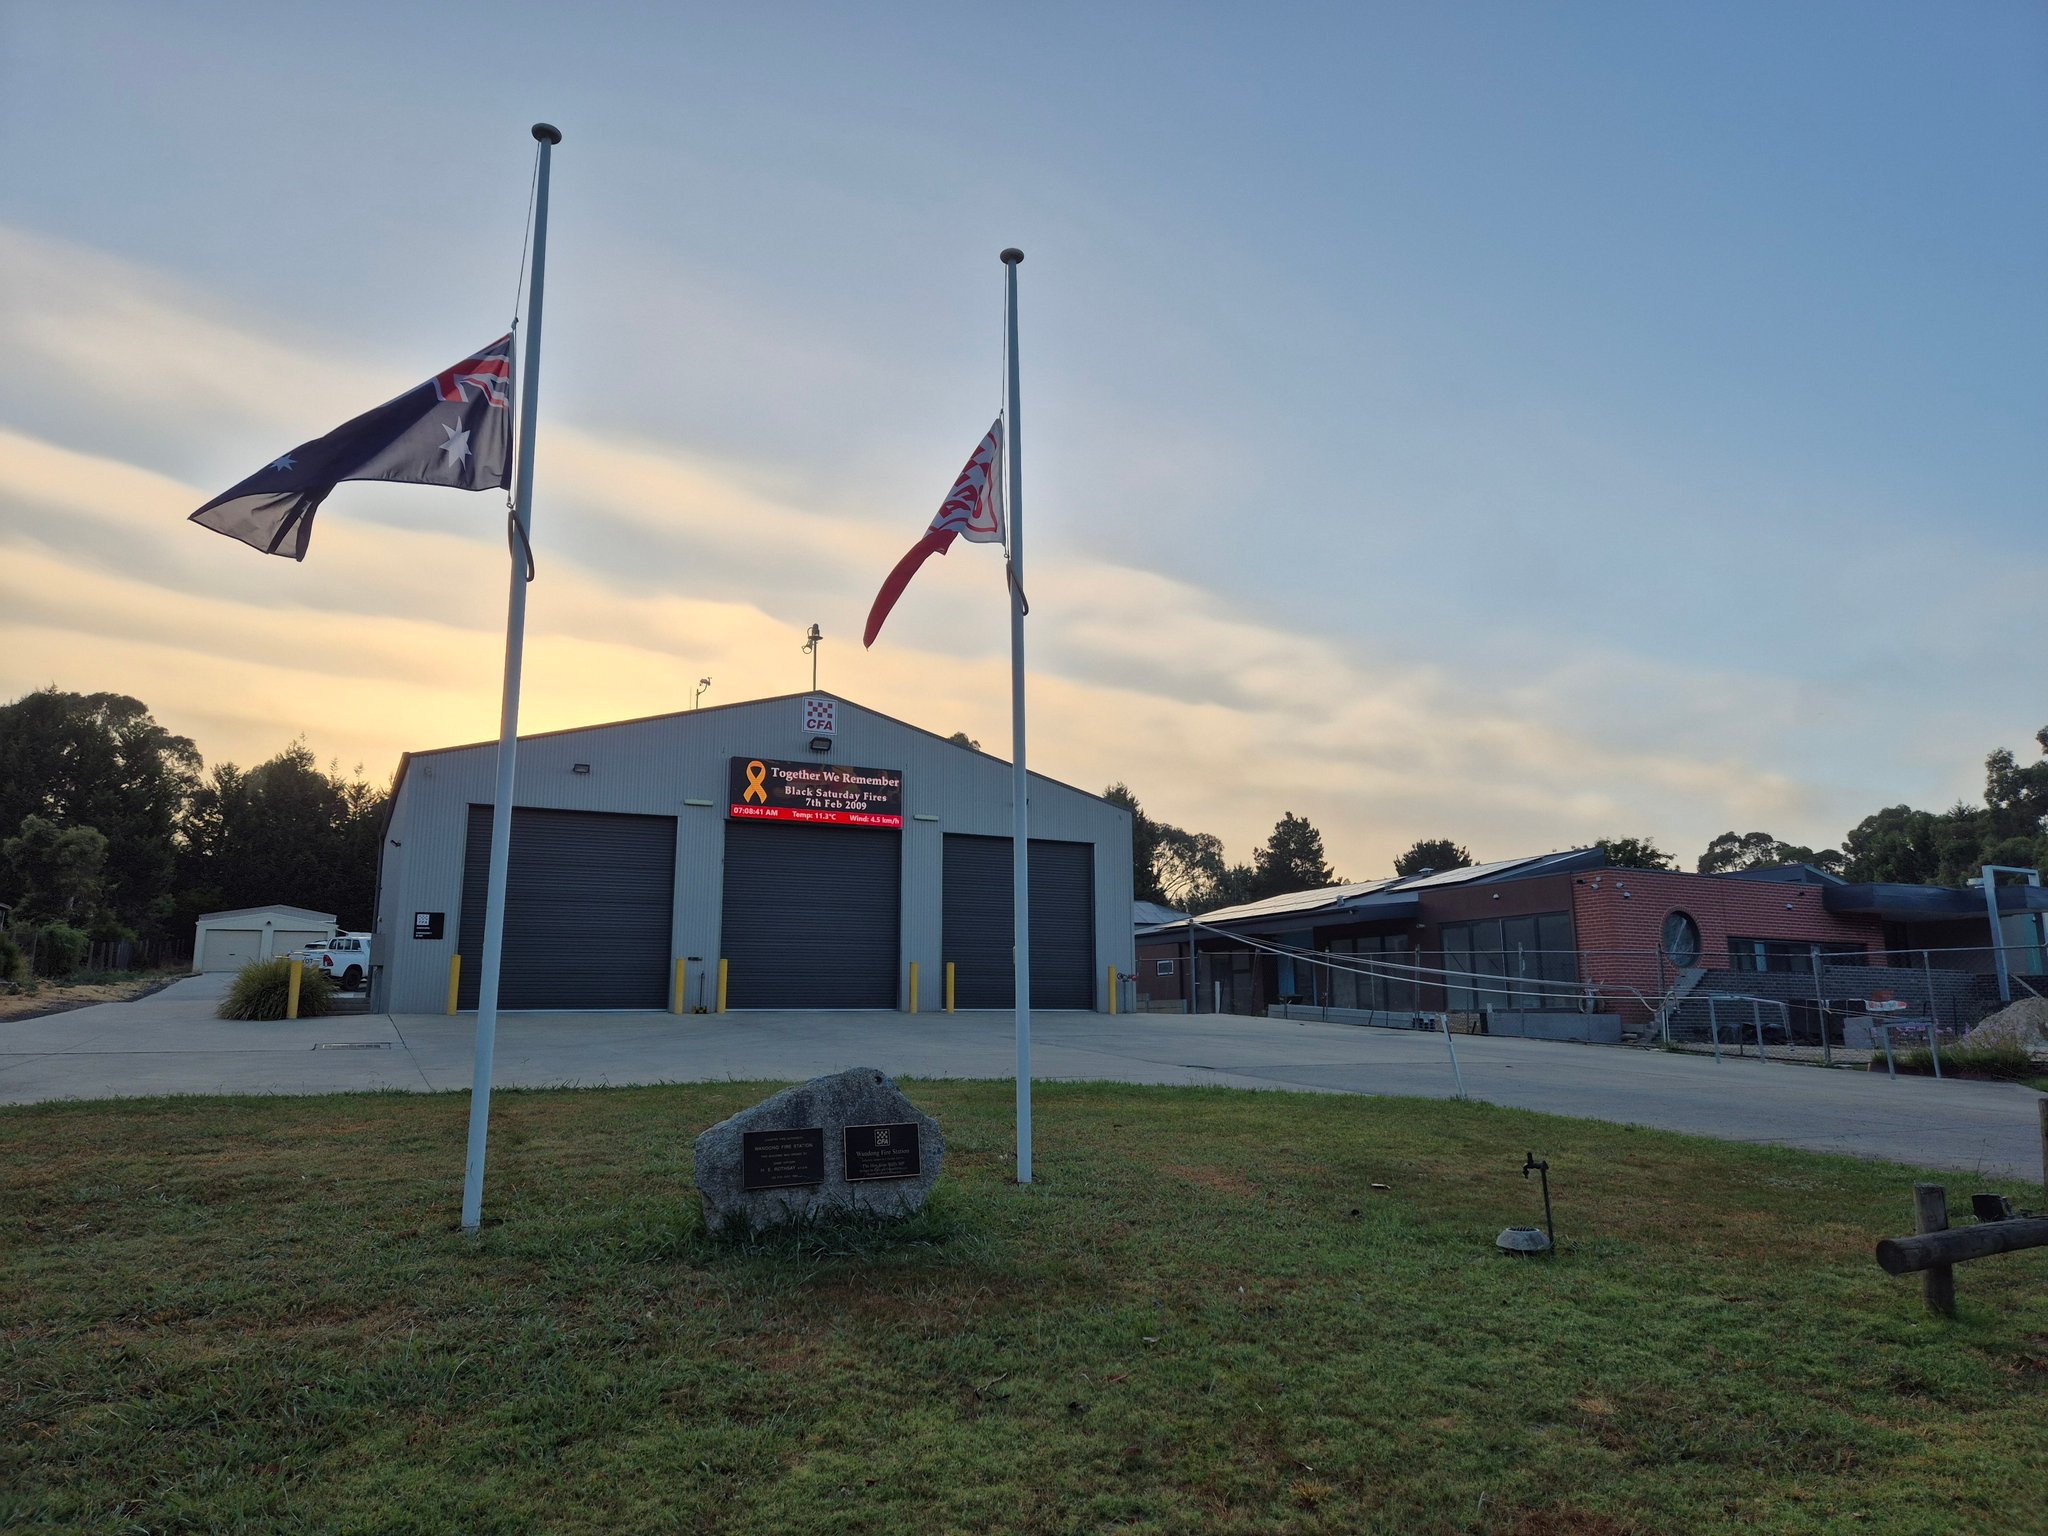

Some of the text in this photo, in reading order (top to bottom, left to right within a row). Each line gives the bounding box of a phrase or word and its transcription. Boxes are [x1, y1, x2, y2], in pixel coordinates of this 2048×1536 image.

[806, 719, 833, 731] CFA
[771, 767, 900, 787] Together We Remember
[785, 786, 887, 802] Black Saturday Fires
[805, 798, 867, 810] 7th Feb 2009
[733, 807, 764, 815] 07:08:41
[792, 810, 813, 820] Temp:
[849, 814, 869, 823] Wind:
[882, 817, 900, 825] km/h
